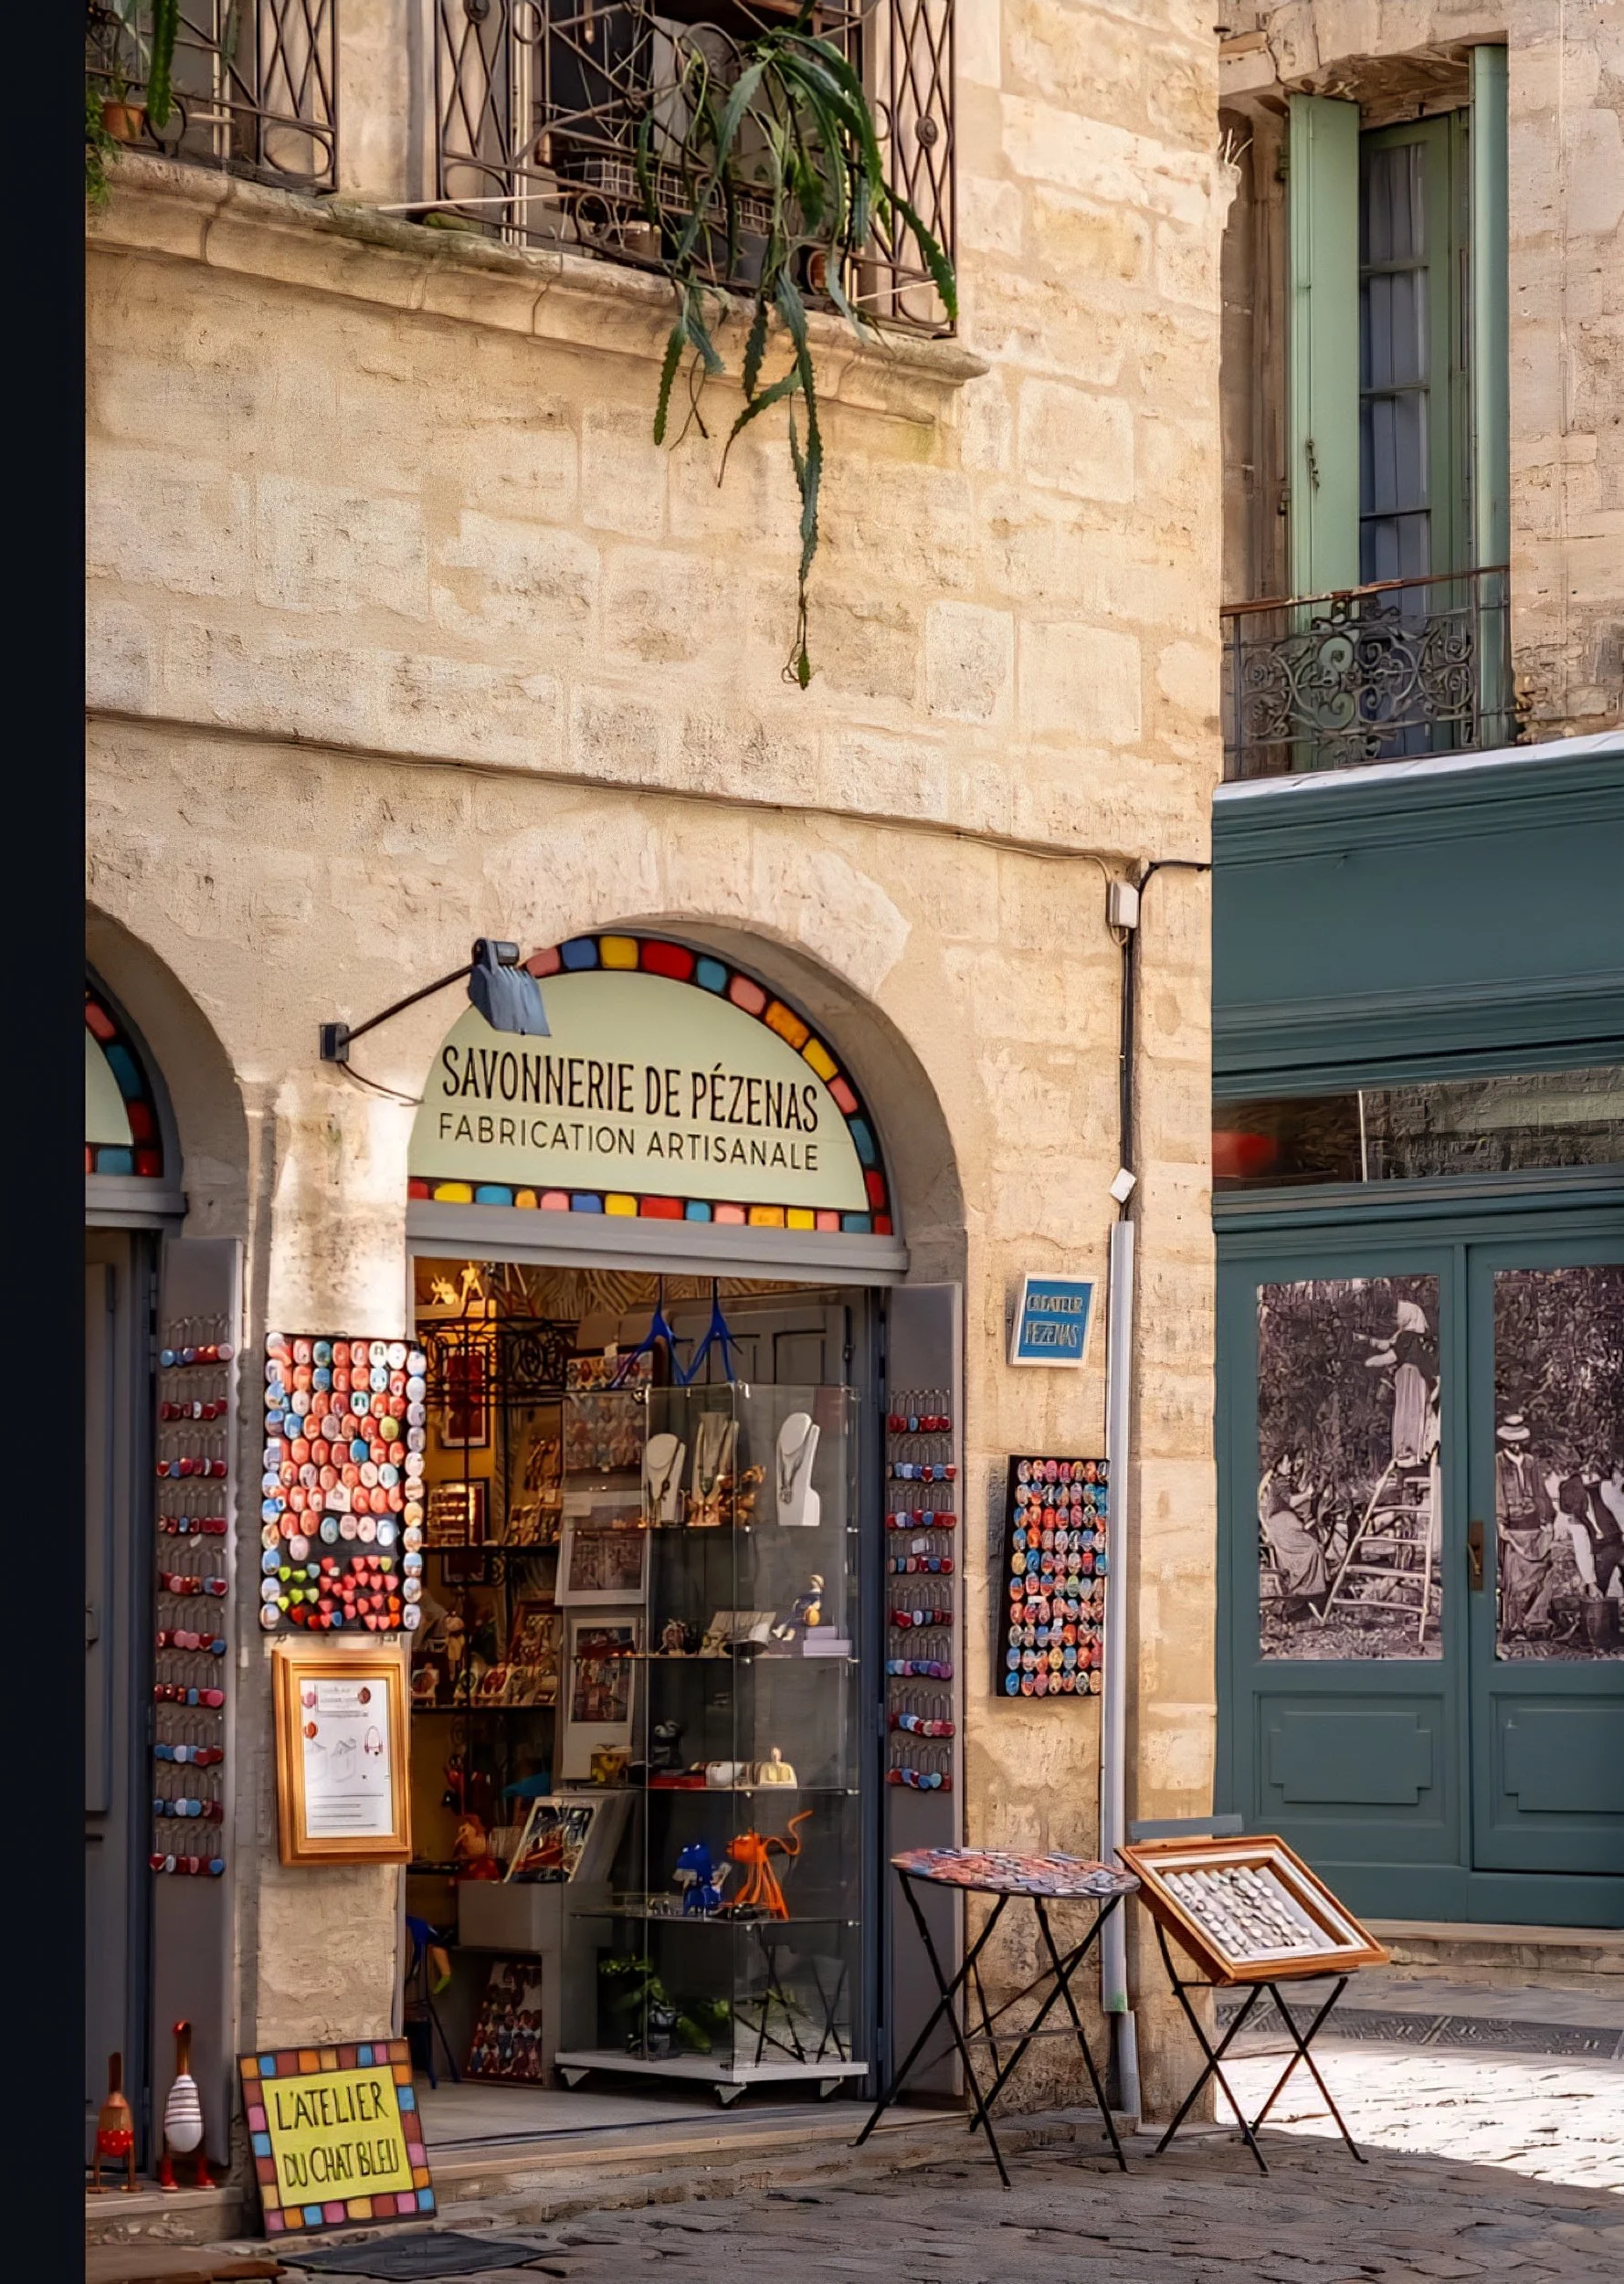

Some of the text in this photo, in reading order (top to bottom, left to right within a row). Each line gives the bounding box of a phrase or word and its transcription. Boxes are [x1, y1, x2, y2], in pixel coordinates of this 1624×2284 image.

[442, 1045, 818, 1133] SAVONNERIE DE PÉZENAS
[438, 1112, 818, 1171] FABRICATION ARTISANALE
[274, 2081, 390, 2131] L'ATELIER
[282, 2138, 400, 2188] DU CHAT BLEU
